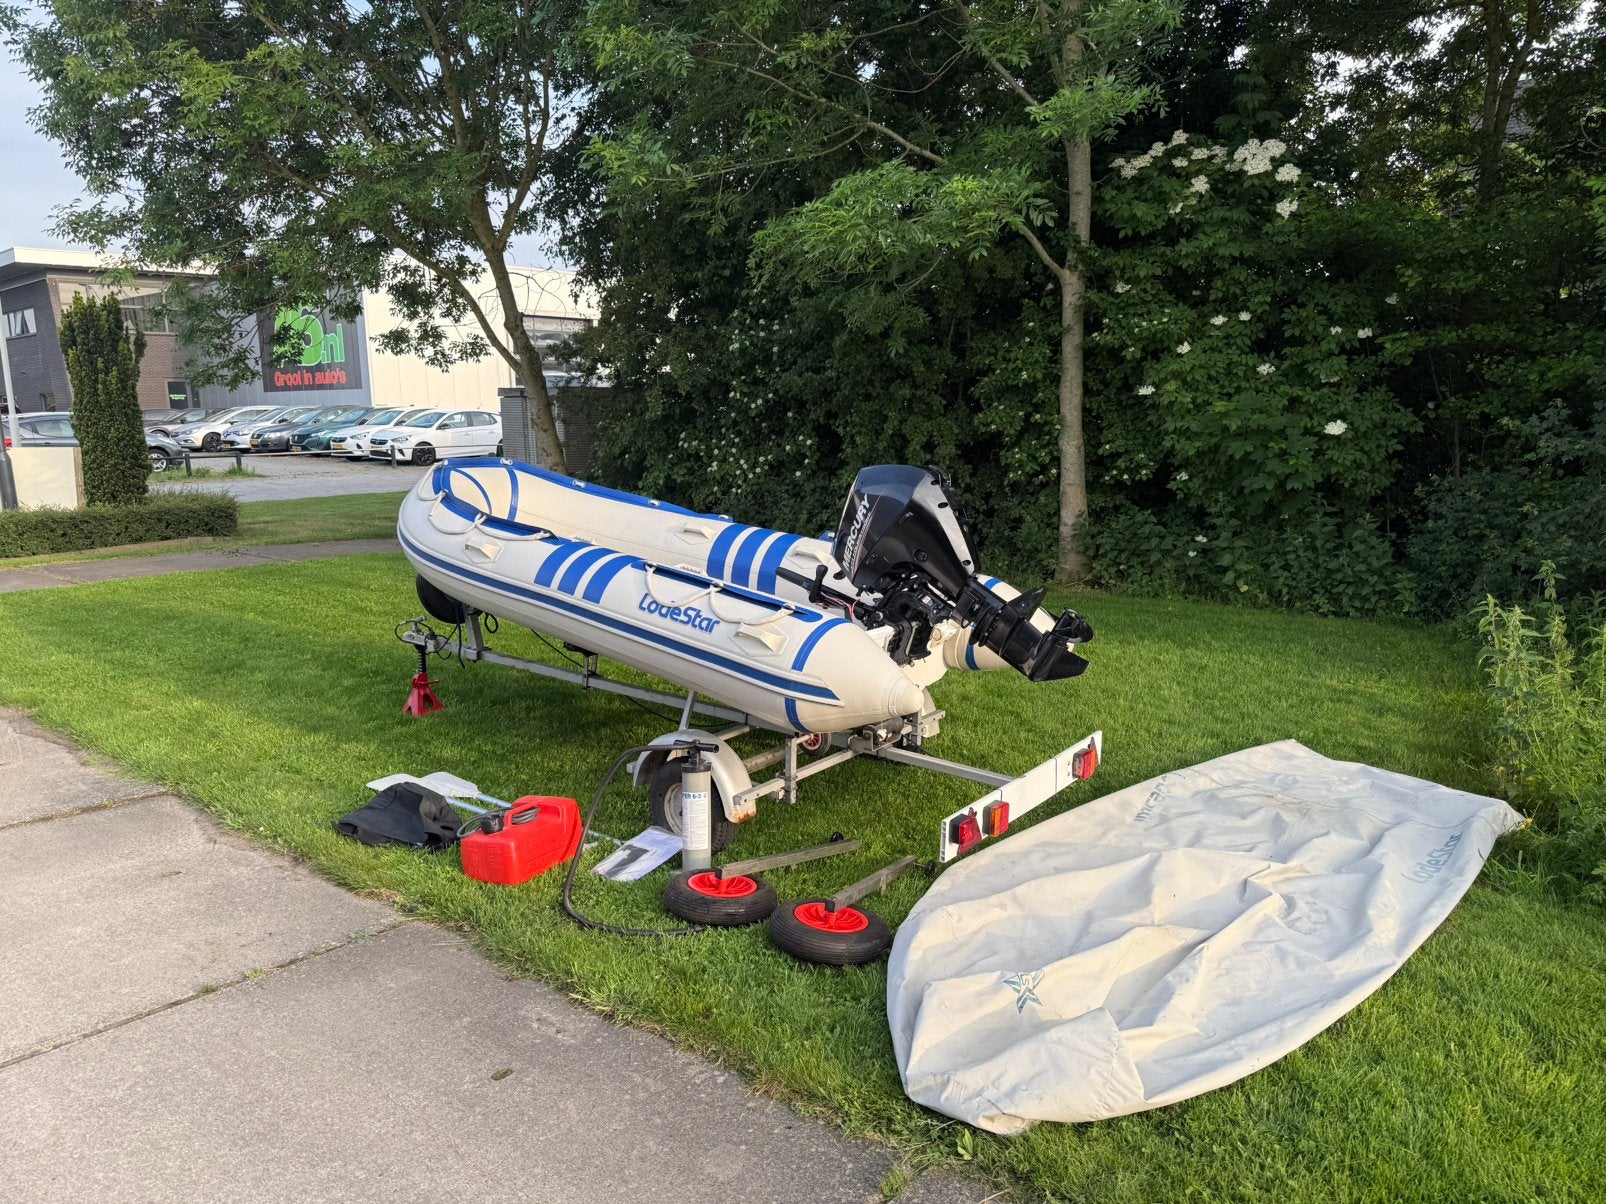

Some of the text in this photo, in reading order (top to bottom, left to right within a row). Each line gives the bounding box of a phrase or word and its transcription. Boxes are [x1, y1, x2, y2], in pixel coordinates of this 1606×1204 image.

[275, 368, 347, 386] Groot in auto's
[842, 493, 871, 572] MERCURY
